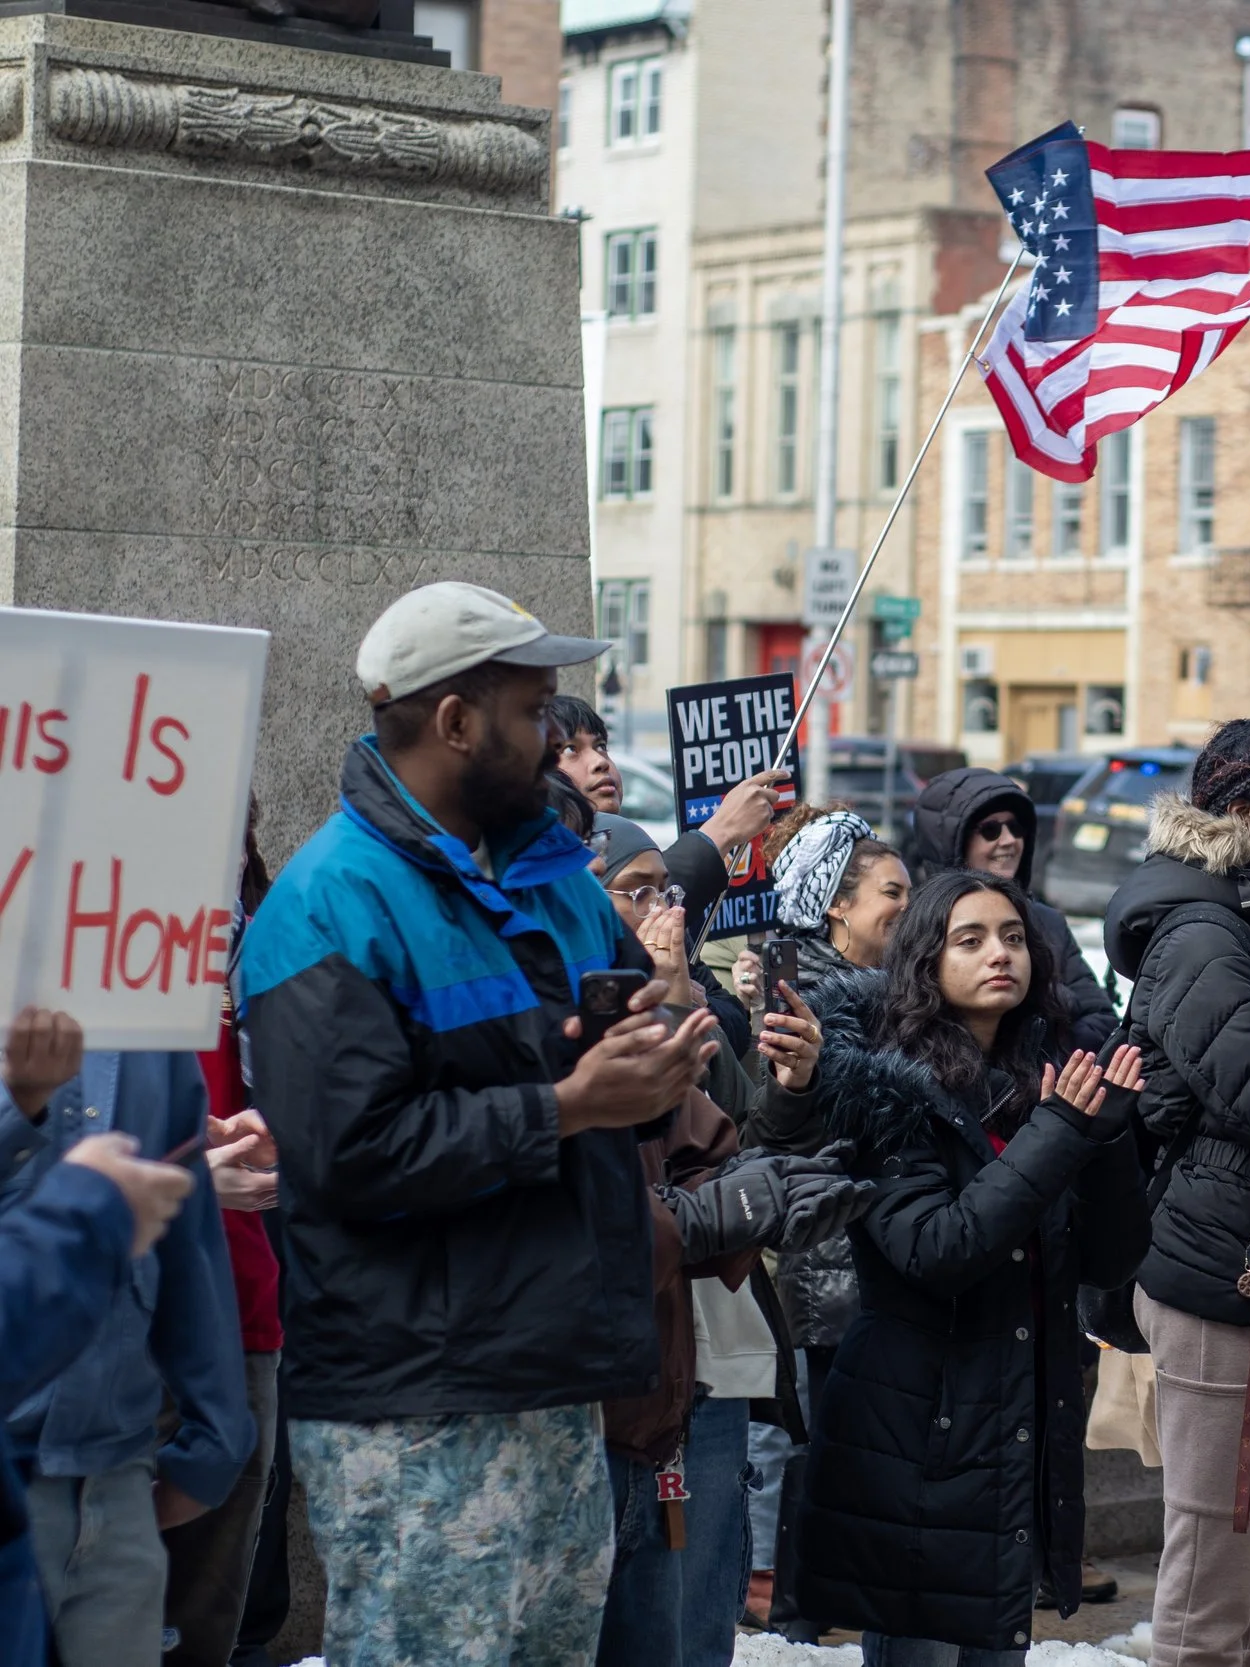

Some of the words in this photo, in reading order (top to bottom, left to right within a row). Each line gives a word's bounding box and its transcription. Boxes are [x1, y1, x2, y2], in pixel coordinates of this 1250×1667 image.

[820, 559, 840, 573] NO
[812, 579, 848, 593] LEFT
[676, 696, 731, 743] WE
[734, 687, 792, 735] THE
[738, 1188, 753, 1220] HEAD
[655, 1472, 691, 1501] R
